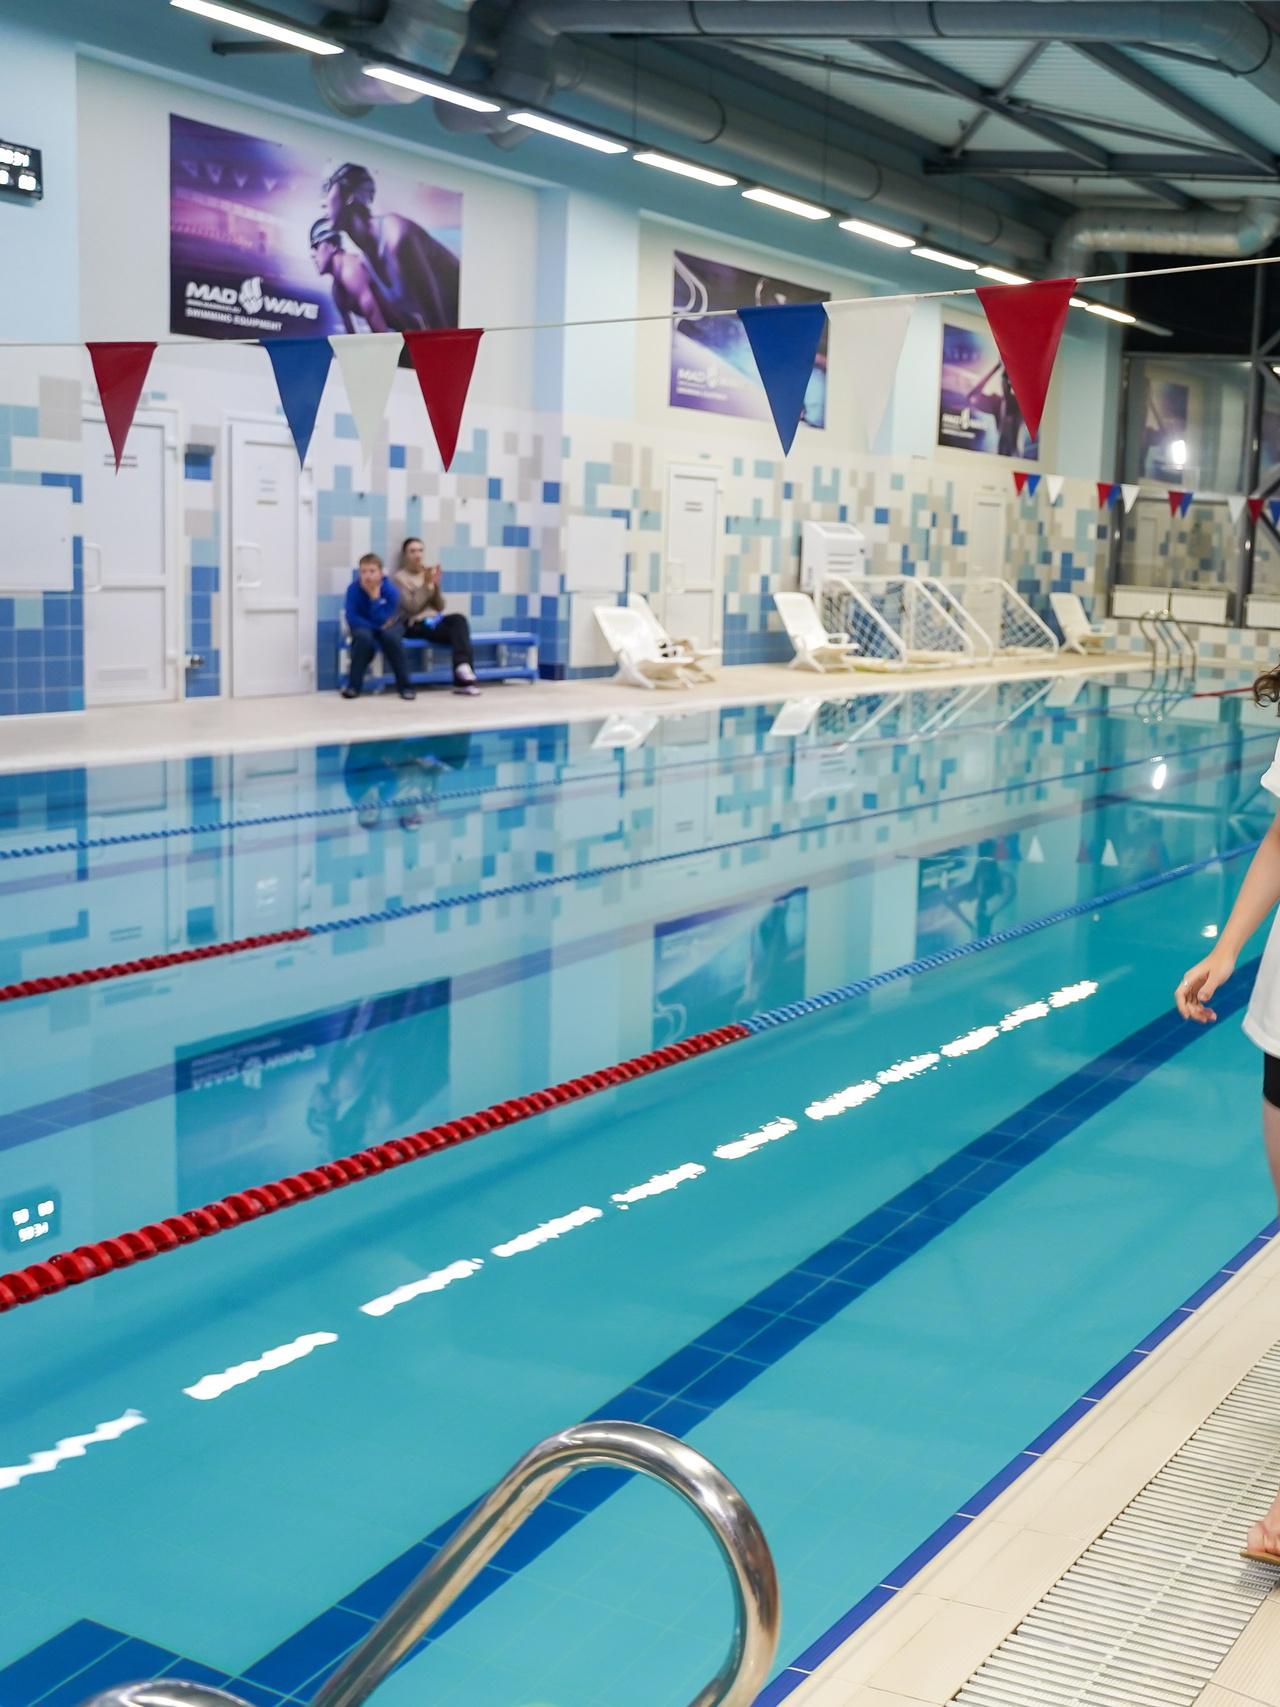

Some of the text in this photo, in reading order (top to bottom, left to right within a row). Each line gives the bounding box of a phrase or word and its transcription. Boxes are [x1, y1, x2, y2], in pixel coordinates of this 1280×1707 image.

[185, 280, 319, 320] MAD WAVE
[184, 307, 284, 332] SWIMMING EQUIPMENT
